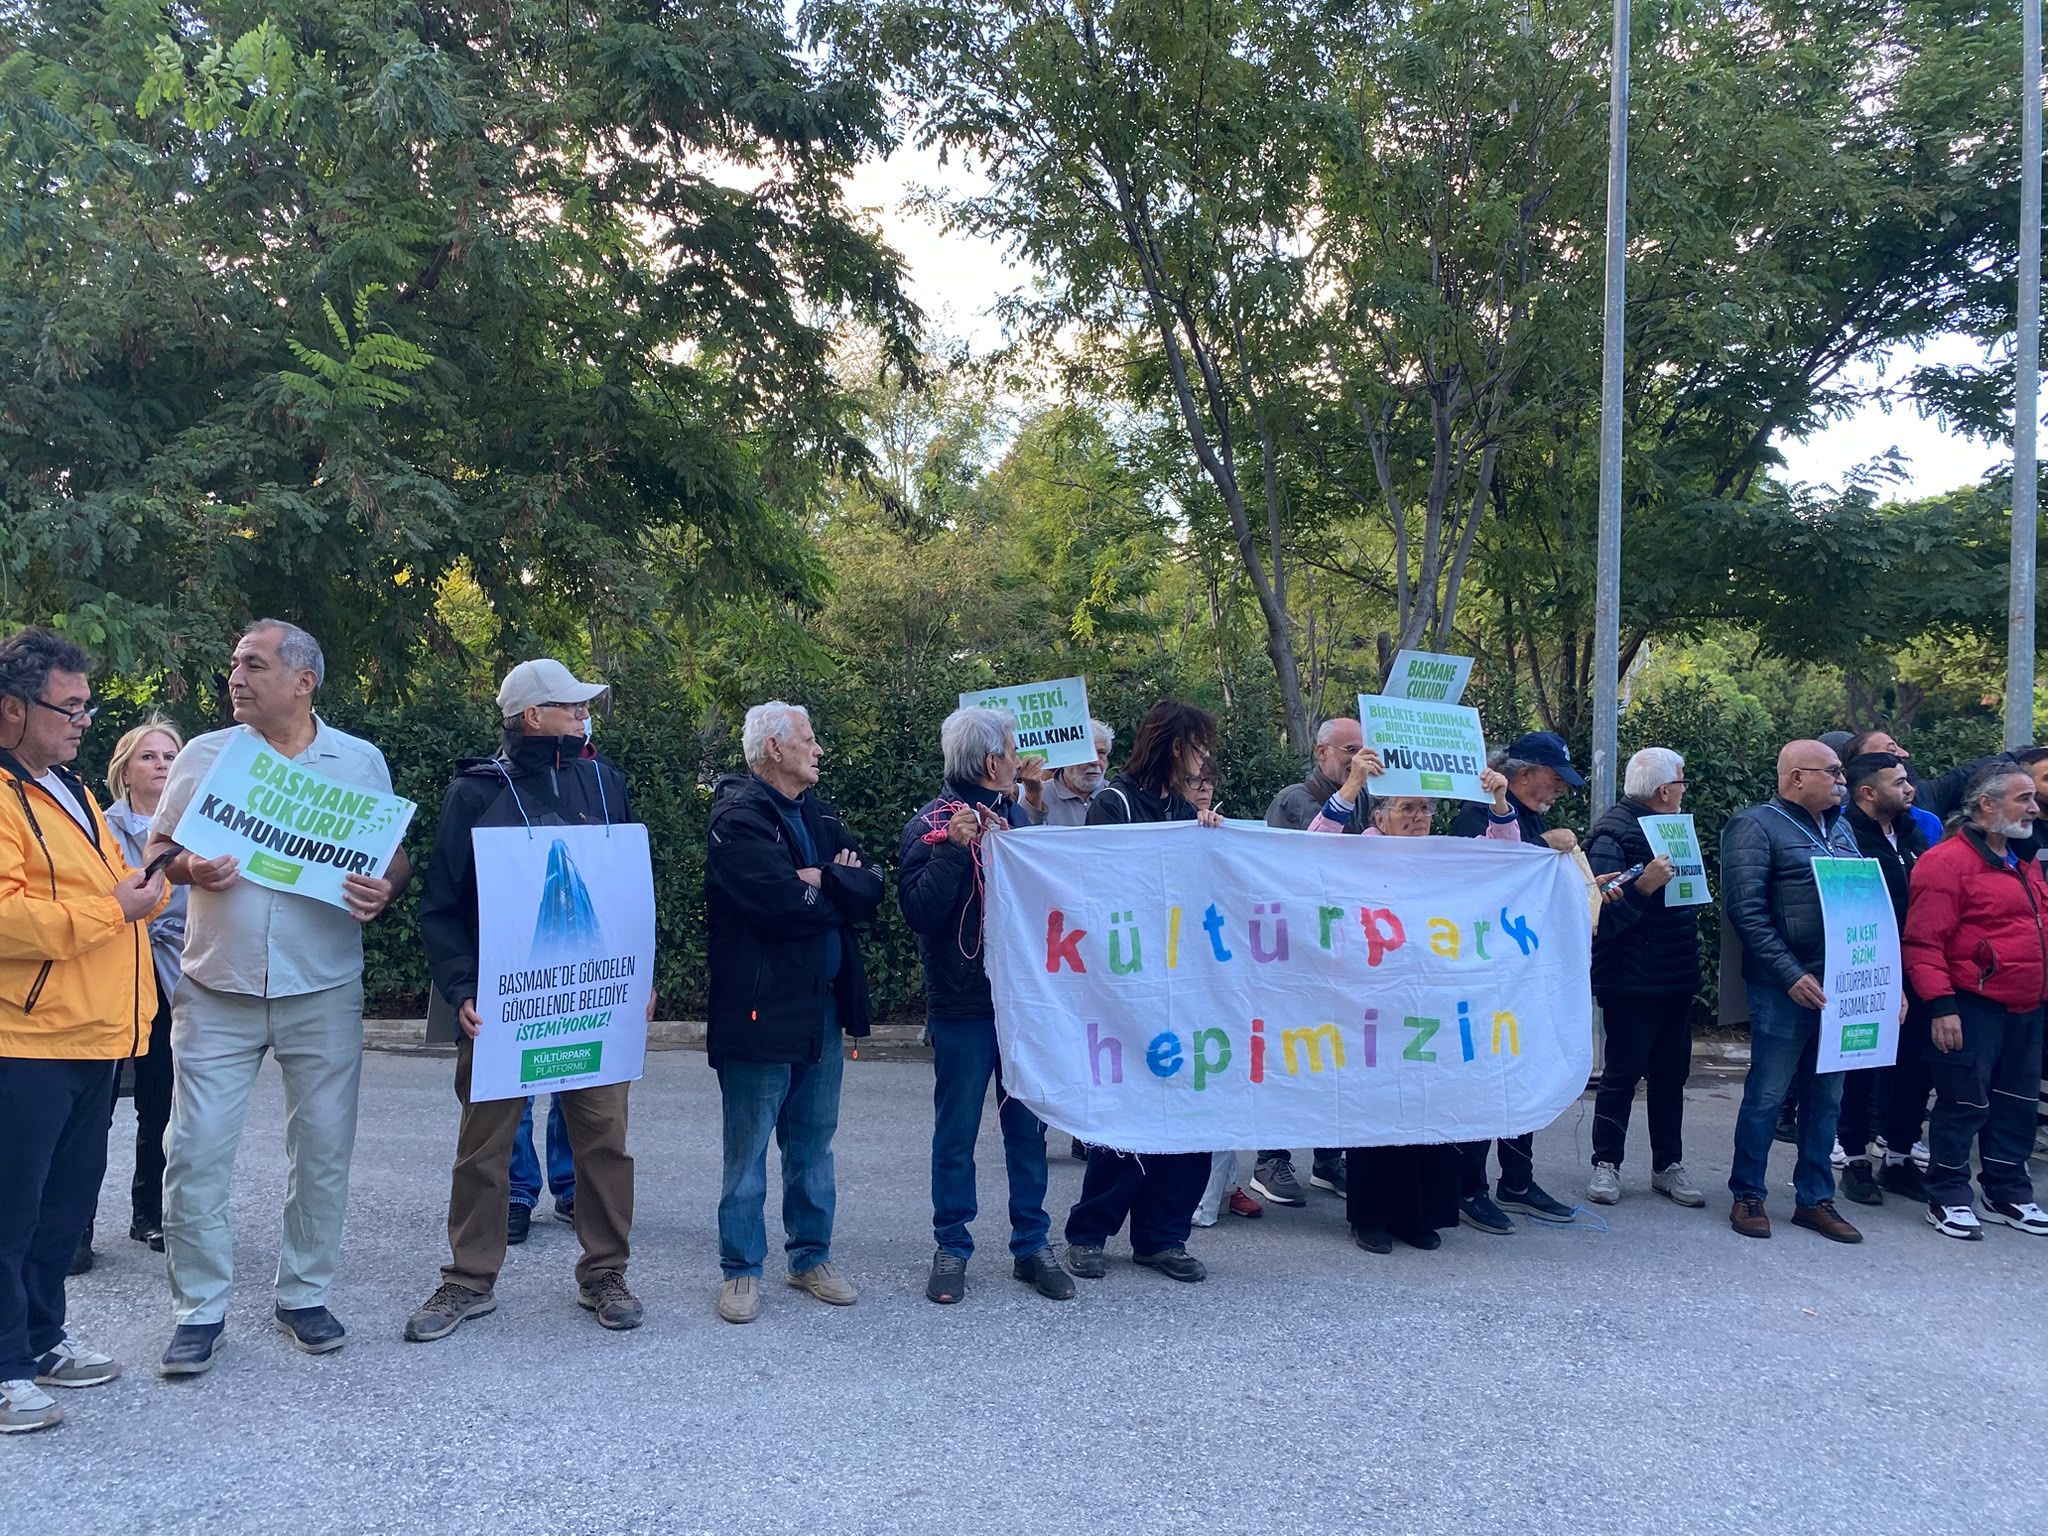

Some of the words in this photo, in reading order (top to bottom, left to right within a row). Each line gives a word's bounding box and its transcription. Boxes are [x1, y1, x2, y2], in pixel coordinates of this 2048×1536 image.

[1407, 660, 1457, 681] BASMANE
[1017, 687, 1068, 712] YETKİ,
[1407, 680, 1449, 700] ÇUKURU
[1369, 704, 1415, 722] BİRLİKTE
[1417, 711, 1475, 731] SAVUNMAK,
[1385, 721, 1422, 735] BİRLİKTE
[1018, 725, 1085, 748] HALKINA!
[1376, 731, 1414, 745] BİRLİKTE
[1383, 746, 1479, 776] MÜCADELE!
[249, 752, 379, 821] BASMANE
[246, 785, 355, 841] ÇUKURU
[199, 794, 379, 877] KAMUNUNDUR!
[1046, 903, 1539, 976] kültürpark
[1846, 927, 1858, 944] BU
[1860, 923, 1878, 940] KENT
[1852, 945, 1876, 965] BİZİM!
[498, 964, 576, 996] BASMANE'DE
[579, 955, 635, 984] GÖKDELEN
[1835, 970, 1873, 994] KÜLTÜRPARK
[502, 991, 576, 1023] GÖKDELENDE
[579, 982, 629, 1011] BELEDİYE
[1839, 996, 1869, 1018] BASMANE
[516, 1010, 612, 1042] İSTEMİYORUZ!
[533, 1048, 591, 1064] KÜLTÜRPARK
[1088, 1001, 1520, 1091] hepimizin
[536, 1061, 588, 1077] PLATFORMU
